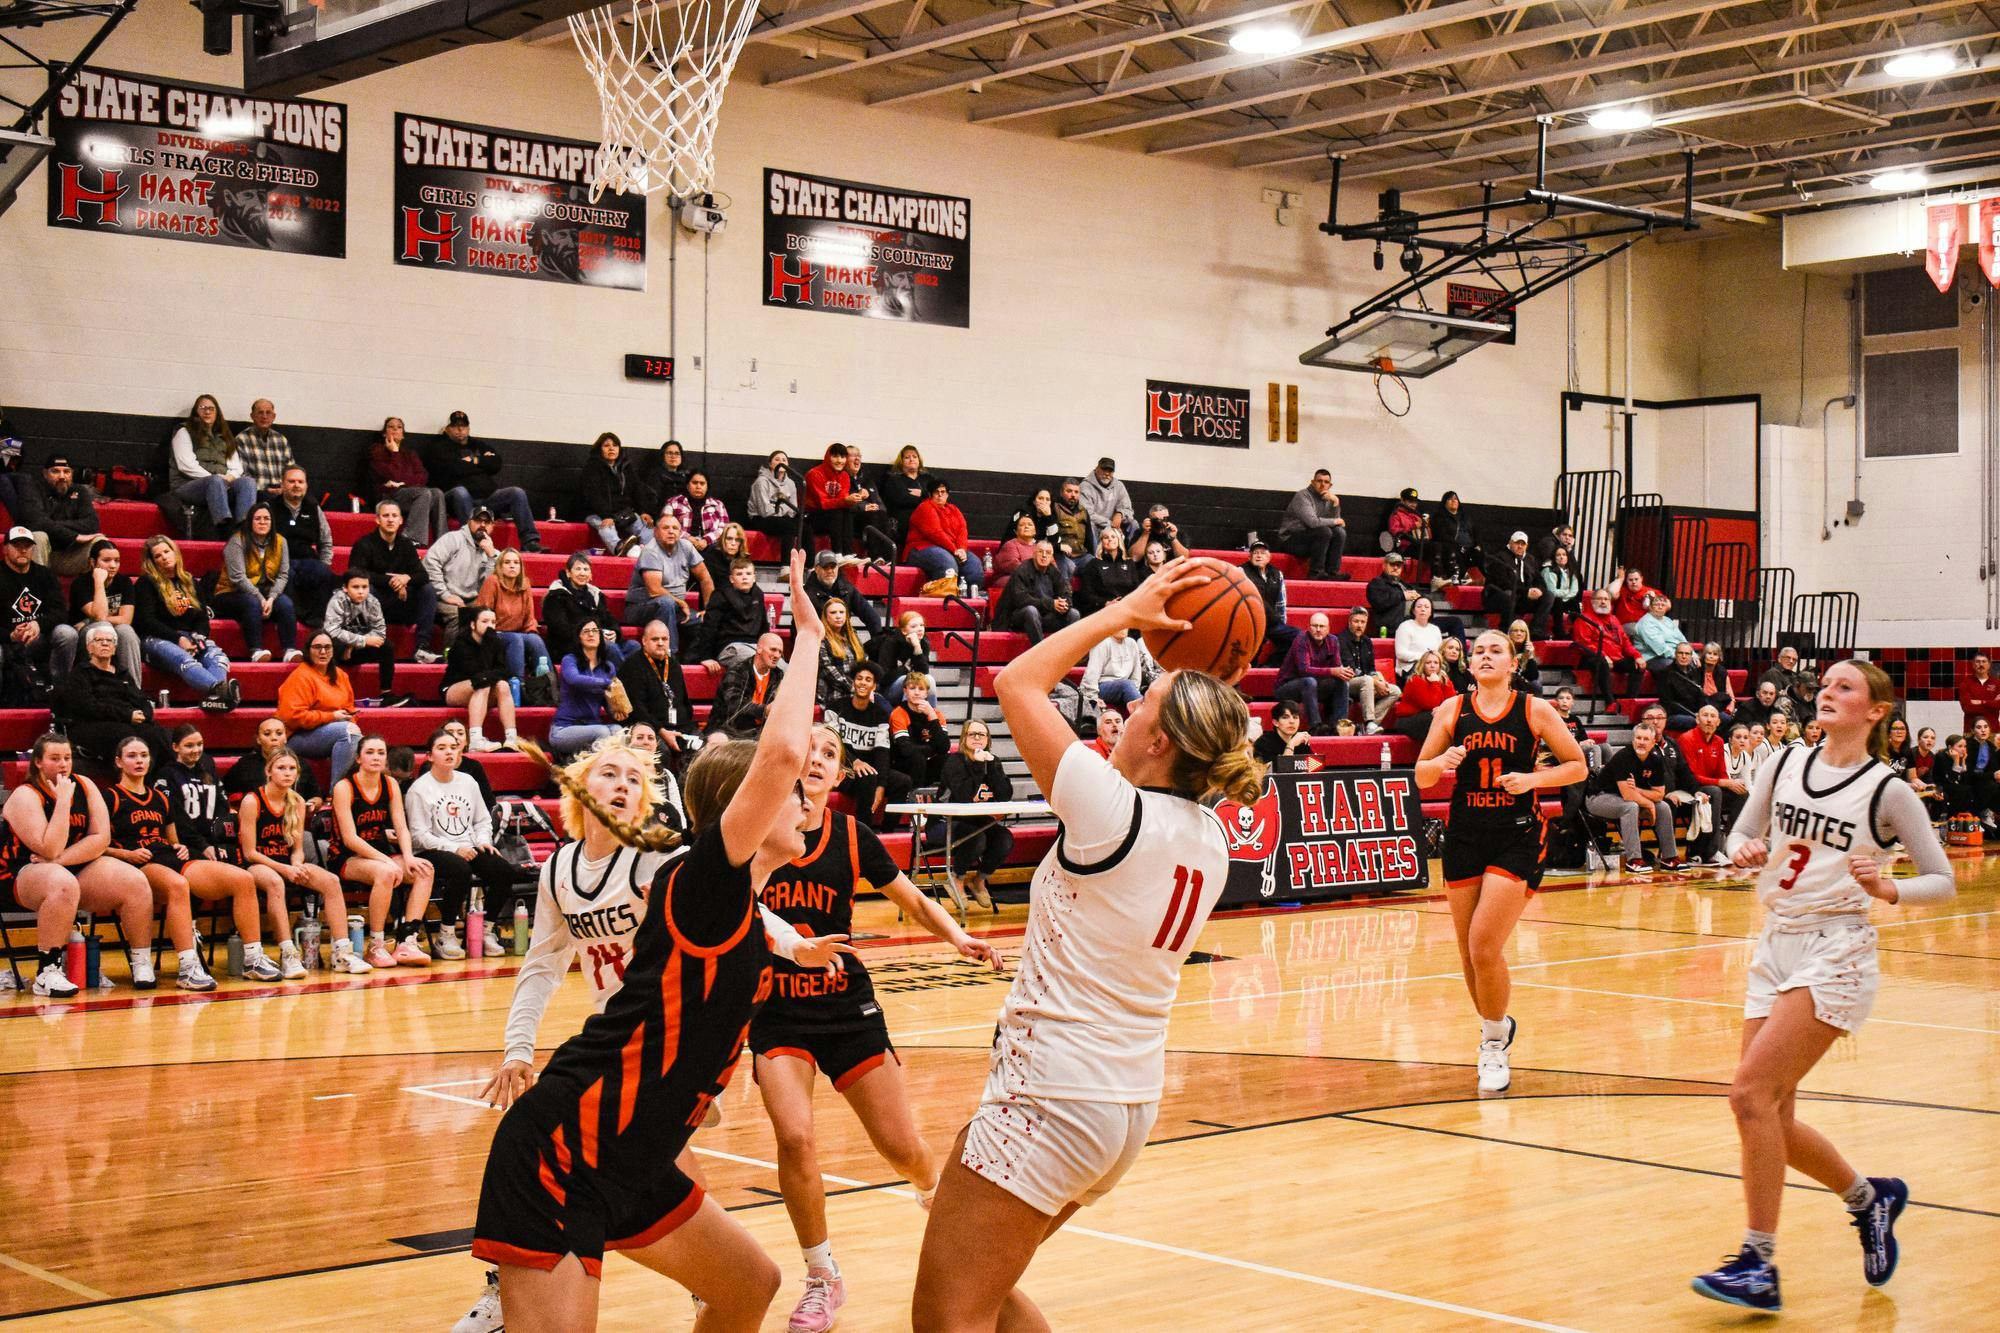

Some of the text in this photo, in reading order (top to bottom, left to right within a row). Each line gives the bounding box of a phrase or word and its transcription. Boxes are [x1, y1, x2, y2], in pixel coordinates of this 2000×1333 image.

[60, 70, 342, 153] STATE CHAMPIONS
[157, 132, 236, 154] DIVISION
[403, 118, 644, 194] STATE CHAMPI
[160, 150, 234, 177] TRACK
[237, 161, 254, 179] &
[256, 162, 319, 188] FIELD
[57, 161, 130, 227] H
[139, 171, 215, 206] HART
[136, 207, 219, 237] PIRATES
[420, 186, 478, 208] GIRLS
[543, 202, 629, 228] COUNTRY
[770, 173, 967, 240] STATE CHAMPIONS
[401, 205, 463, 265] H
[470, 214, 535, 246] HART
[467, 246, 539, 273] PIRATES
[882, 248, 954, 270] COUNTRY
[769, 252, 819, 305] H
[644, 360, 672, 375] 7:33
[1147, 390, 1249, 437] H PARENT
[1193, 417, 1242, 439] POSSE
[202, 701, 228, 709] SOREL
[1463, 731, 1517, 753] GRANT
[1479, 758, 1502, 788] 11
[181, 783, 216, 819] 87
[1296, 778, 1410, 836] HART
[1467, 791, 1515, 807] TIGERS
[70, 814, 86, 828] ANT
[130, 810, 164, 824] GRANT
[357, 810, 387, 825] GRANT
[1286, 836, 1419, 889] PIRATES
[1779, 844, 1811, 890] 3
[763, 881, 837, 914] GRANT
[1151, 864, 1204, 953] 11
[587, 943, 625, 990] 14
[775, 971, 849, 999] TIGERS
